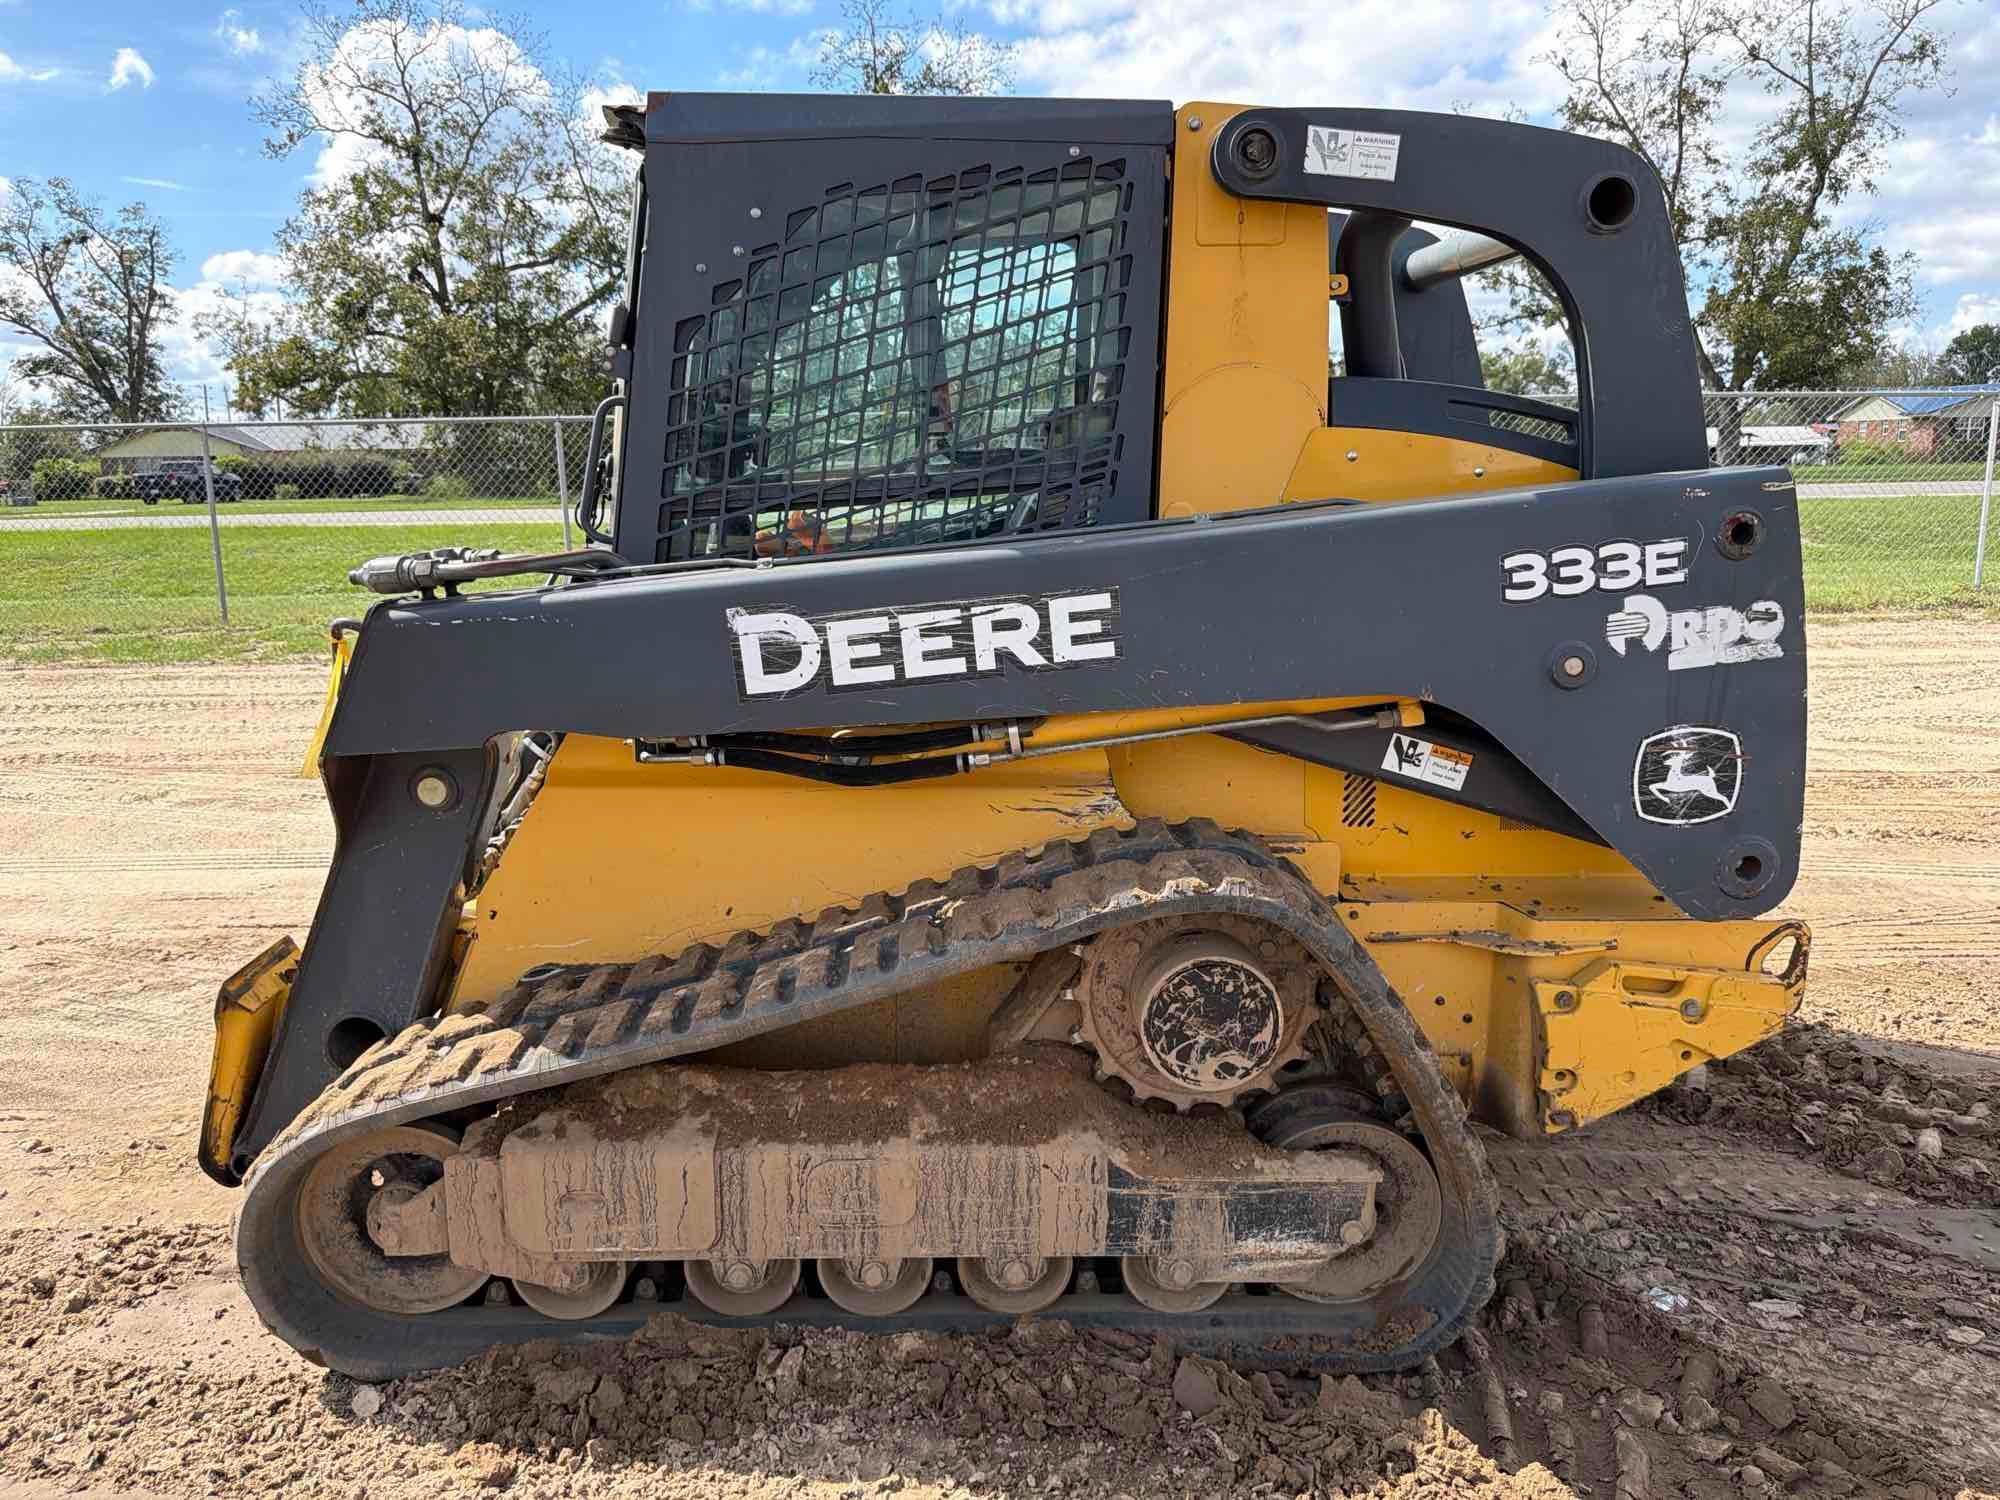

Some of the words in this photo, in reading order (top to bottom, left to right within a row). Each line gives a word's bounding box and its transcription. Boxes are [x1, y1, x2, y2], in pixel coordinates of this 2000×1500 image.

[1362, 135, 1396, 146] WARNING
[1503, 540, 1688, 601] 333E
[733, 592, 1116, 695] DEERE
